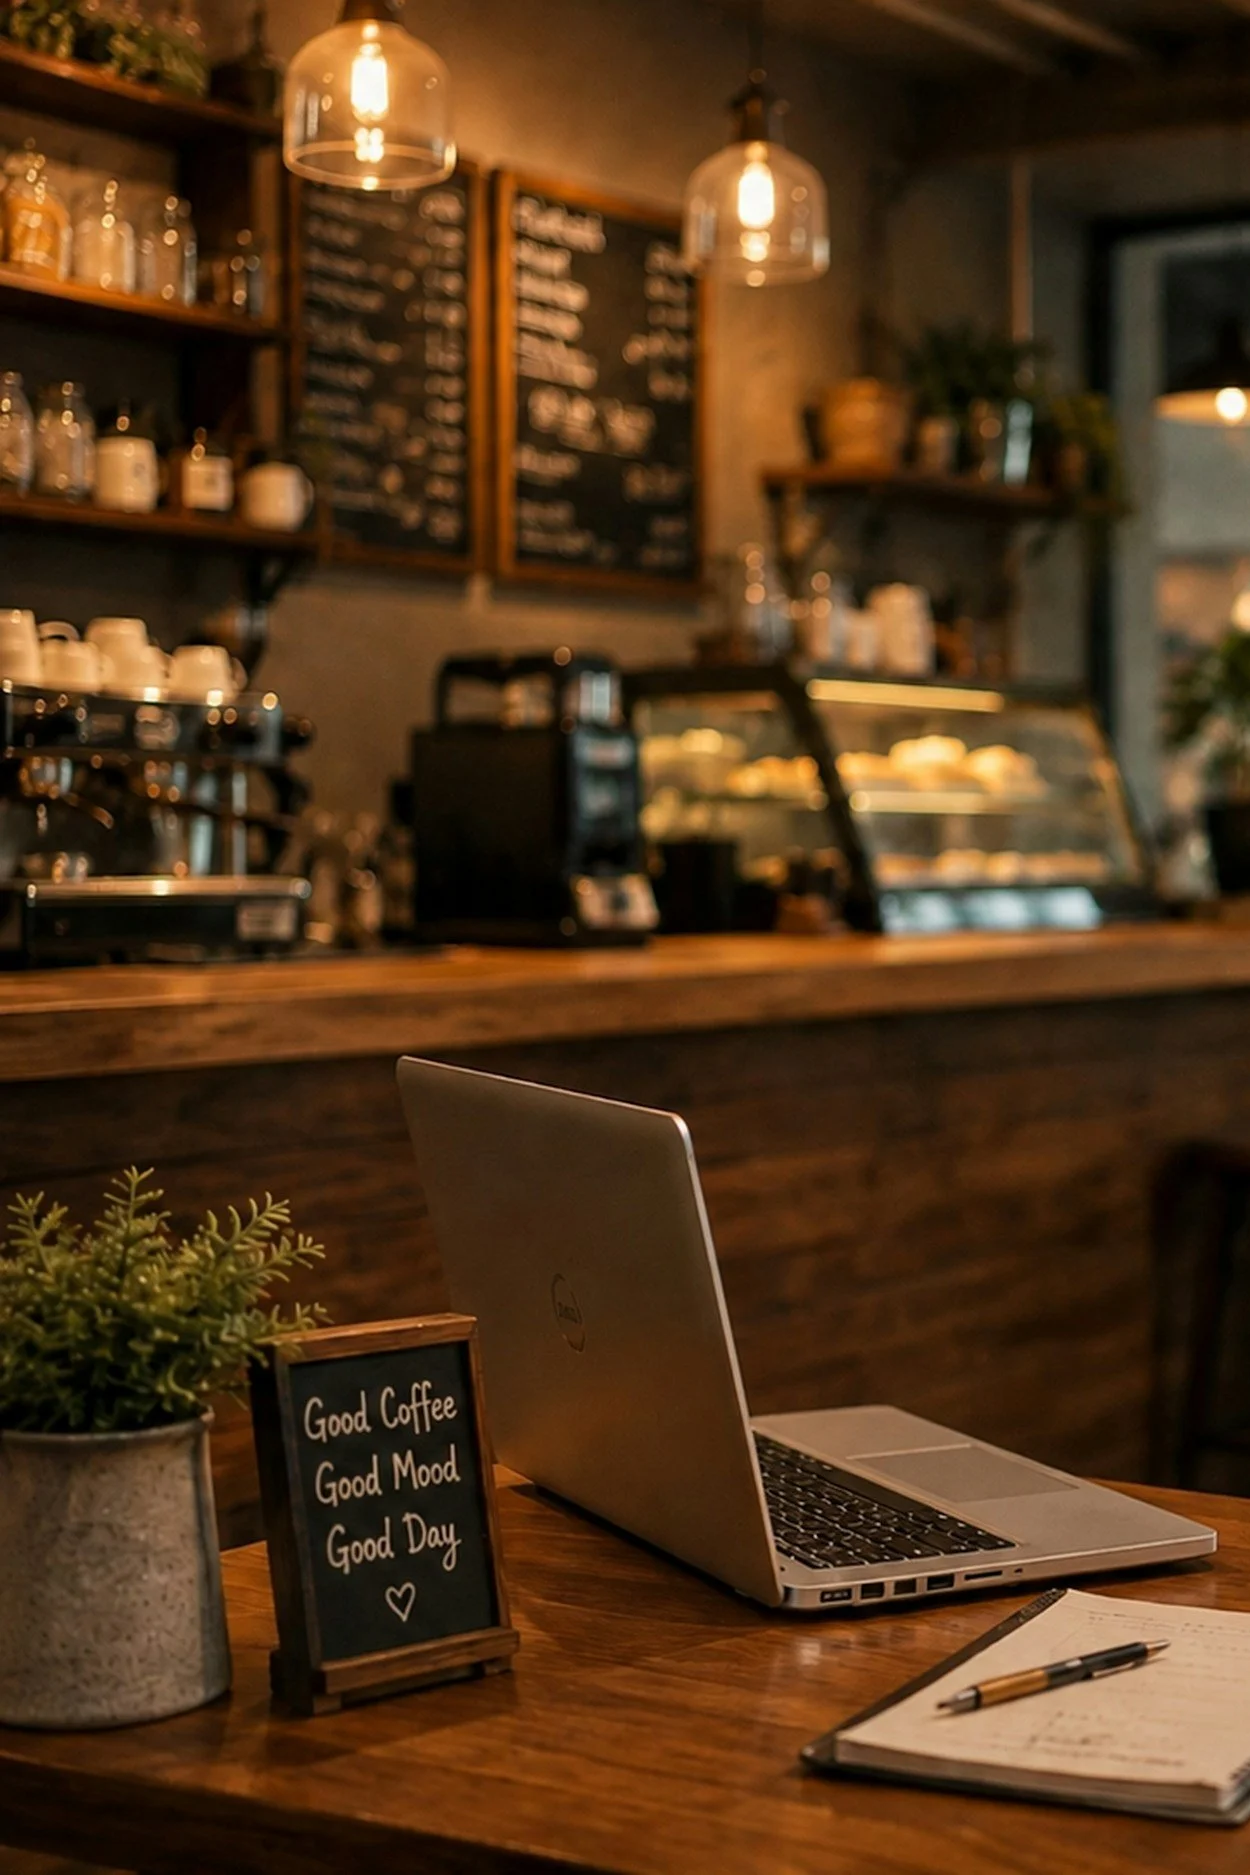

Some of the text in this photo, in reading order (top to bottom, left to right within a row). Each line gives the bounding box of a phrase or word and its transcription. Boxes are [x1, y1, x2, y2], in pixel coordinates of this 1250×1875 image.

[305, 1381, 457, 1442] Good Coffee
[316, 1444, 460, 1506] Good Mood
[327, 1513, 461, 1574] Good Day
